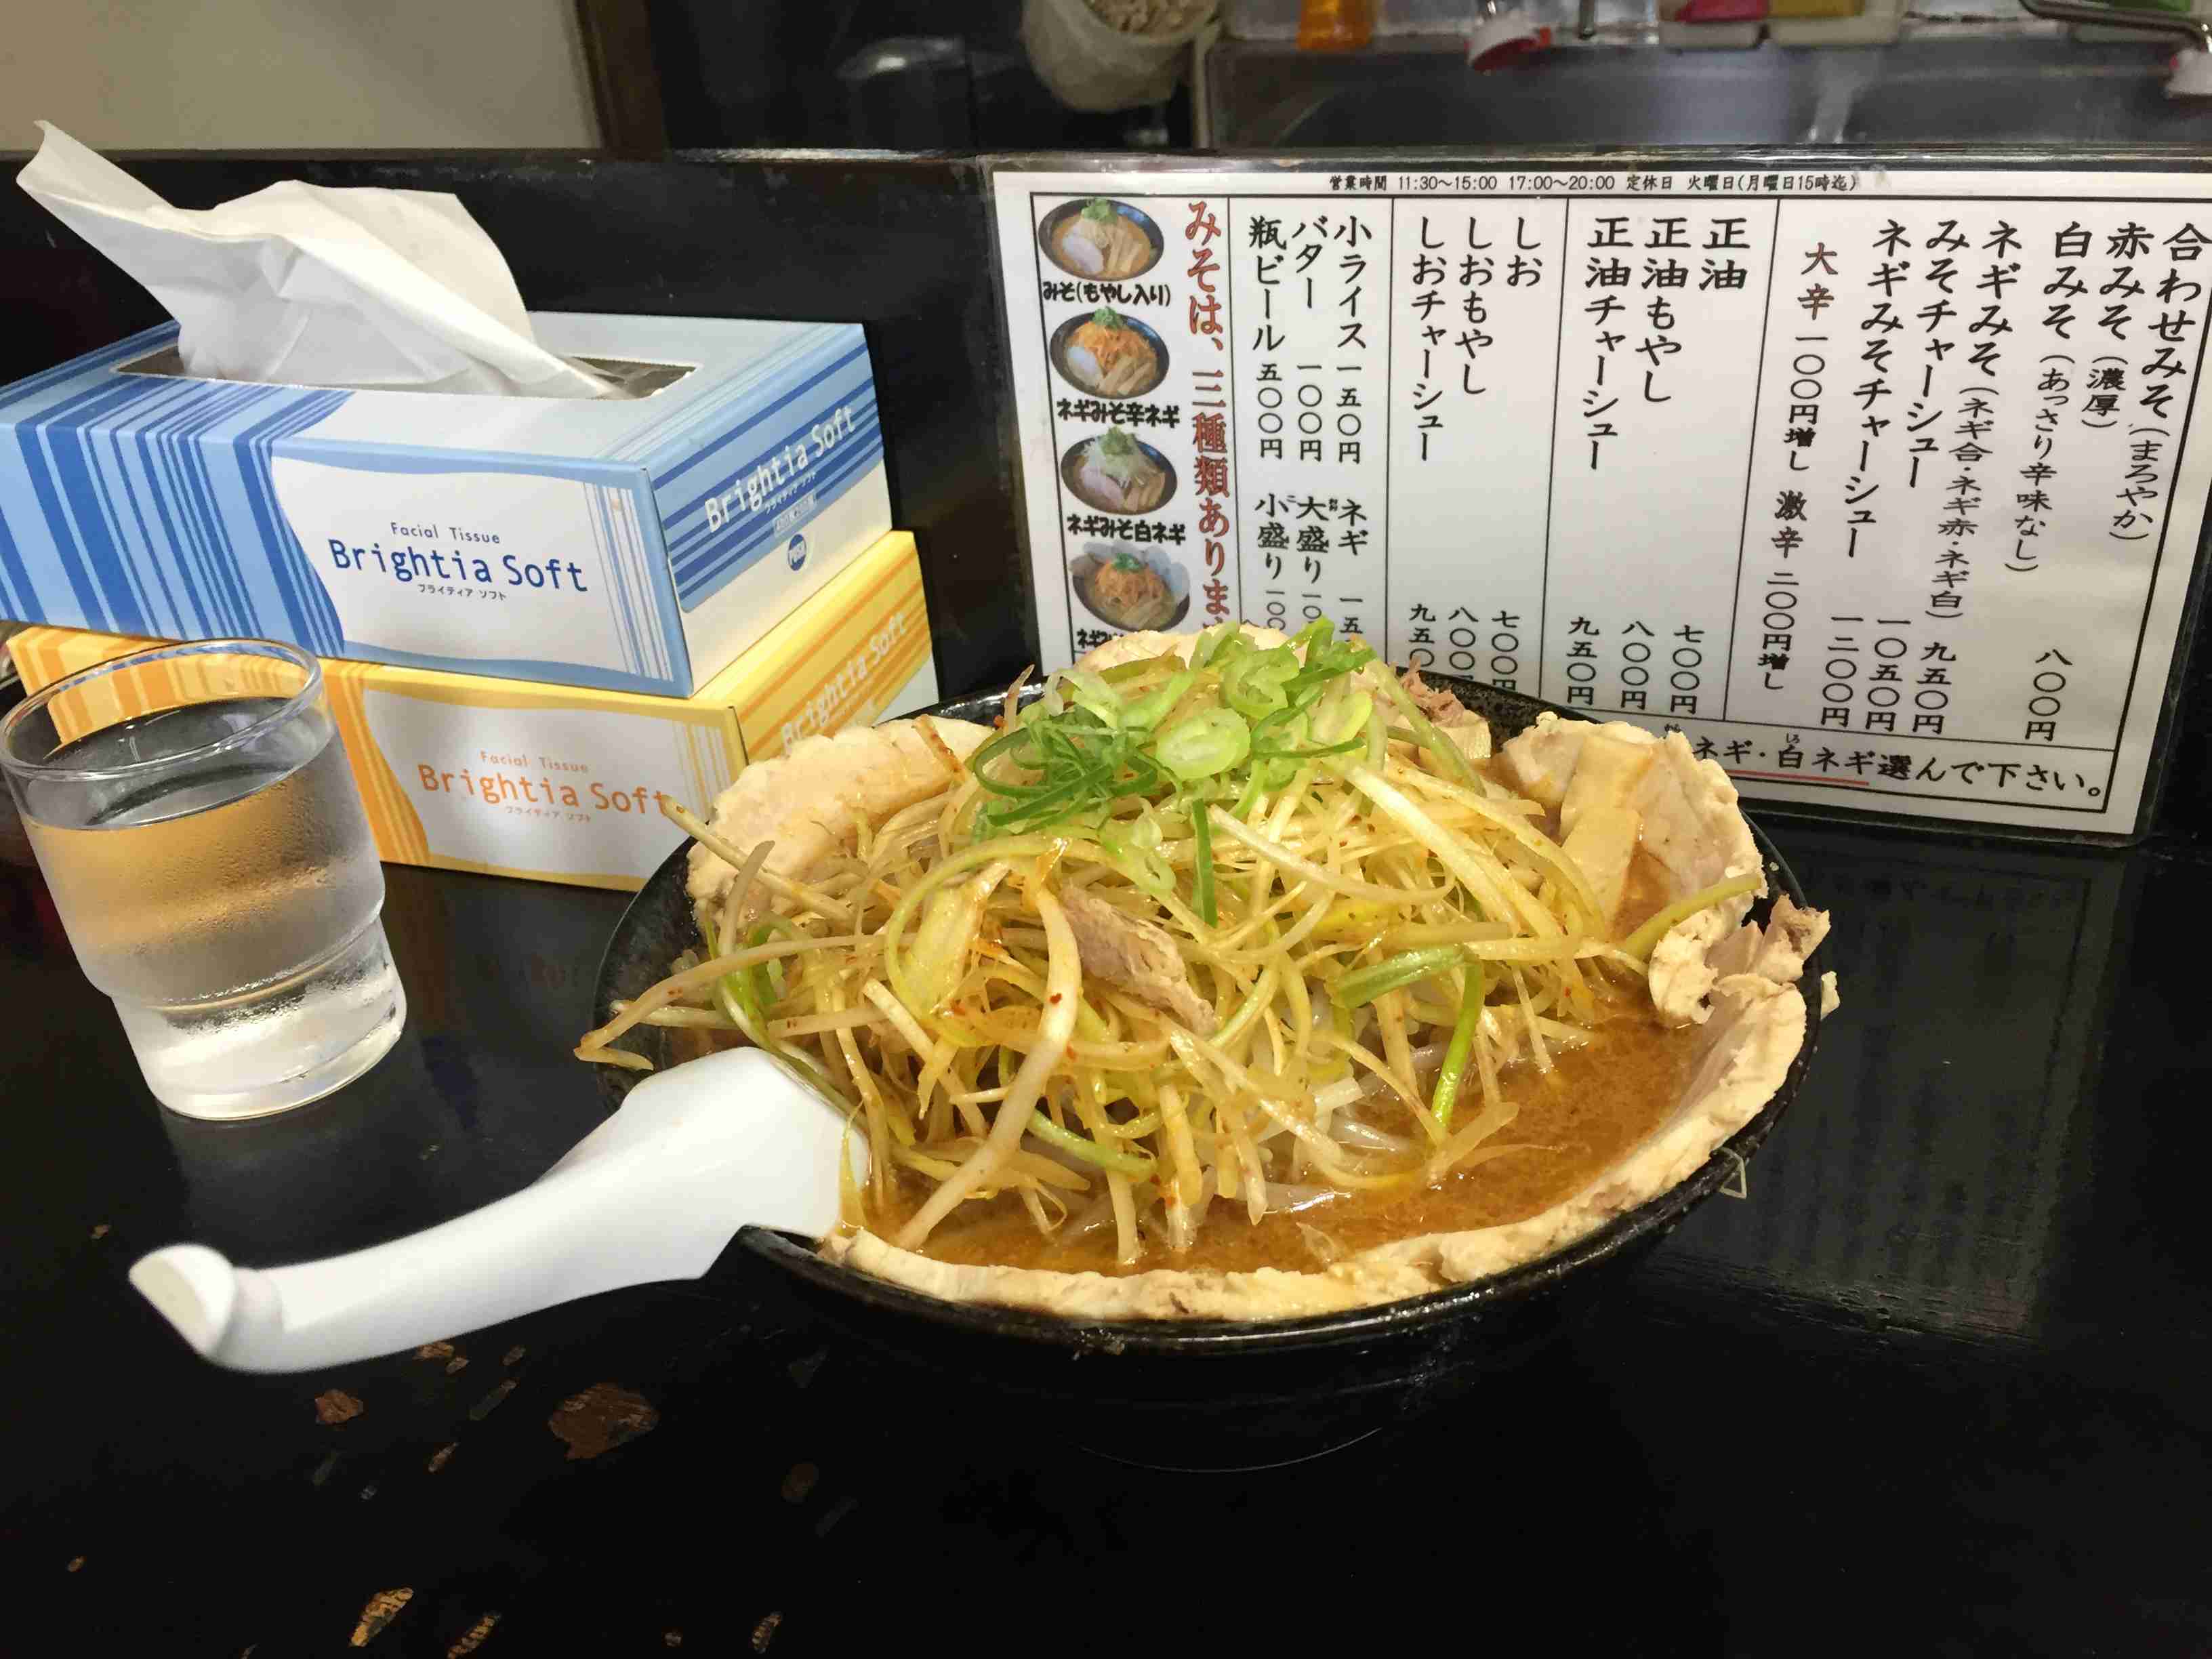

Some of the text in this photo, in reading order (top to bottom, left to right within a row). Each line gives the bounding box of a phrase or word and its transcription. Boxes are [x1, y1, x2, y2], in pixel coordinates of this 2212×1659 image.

[1330, 175, 1387, 191] 営業時間
[1626, 176, 1673, 192] 定休日
[1249, 216, 1287, 352] 瓶ビール
[1292, 216, 1328, 309] バター
[1334, 216, 1372, 350] 小ライス
[1507, 216, 1542, 287] しお
[1699, 217, 1750, 290] 正油
[1797, 242, 1839, 320] 大辛
[2043, 222, 2093, 340] 白みそ
[2098, 222, 2154, 340] 赤みそ
[1411, 216, 1447, 461] しおチャーシュー
[1455, 216, 1494, 394] しおもやし
[1583, 216, 1634, 470] 正油チャーシュー
[1635, 217, 1692, 403] 正油もやし
[1844, 219, 1911, 558] ネギみそチャーシュー
[1907, 220, 1970, 487] みそチャーシュー
[1057, 400, 1180, 429] ネギみそ辛ネギ
[1185, 201, 1230, 628] みそは、三種類ありま
[705, 442, 808, 533] Brightia
[813, 405, 857, 457] Soft
[329, 539, 588, 592] Brightia Soft
[390, 522, 501, 544] Facial Tissue
[1067, 514, 1186, 545] ネギみそ白ネギ
[1254, 493, 1289, 580] 小盛り
[1296, 496, 1329, 583] 大盛り
[1338, 499, 1369, 556] ネギ
[1771, 490, 1807, 558] 激辛
[417, 763, 580, 808] Brightia
[480, 750, 588, 774] Facial Tissue
